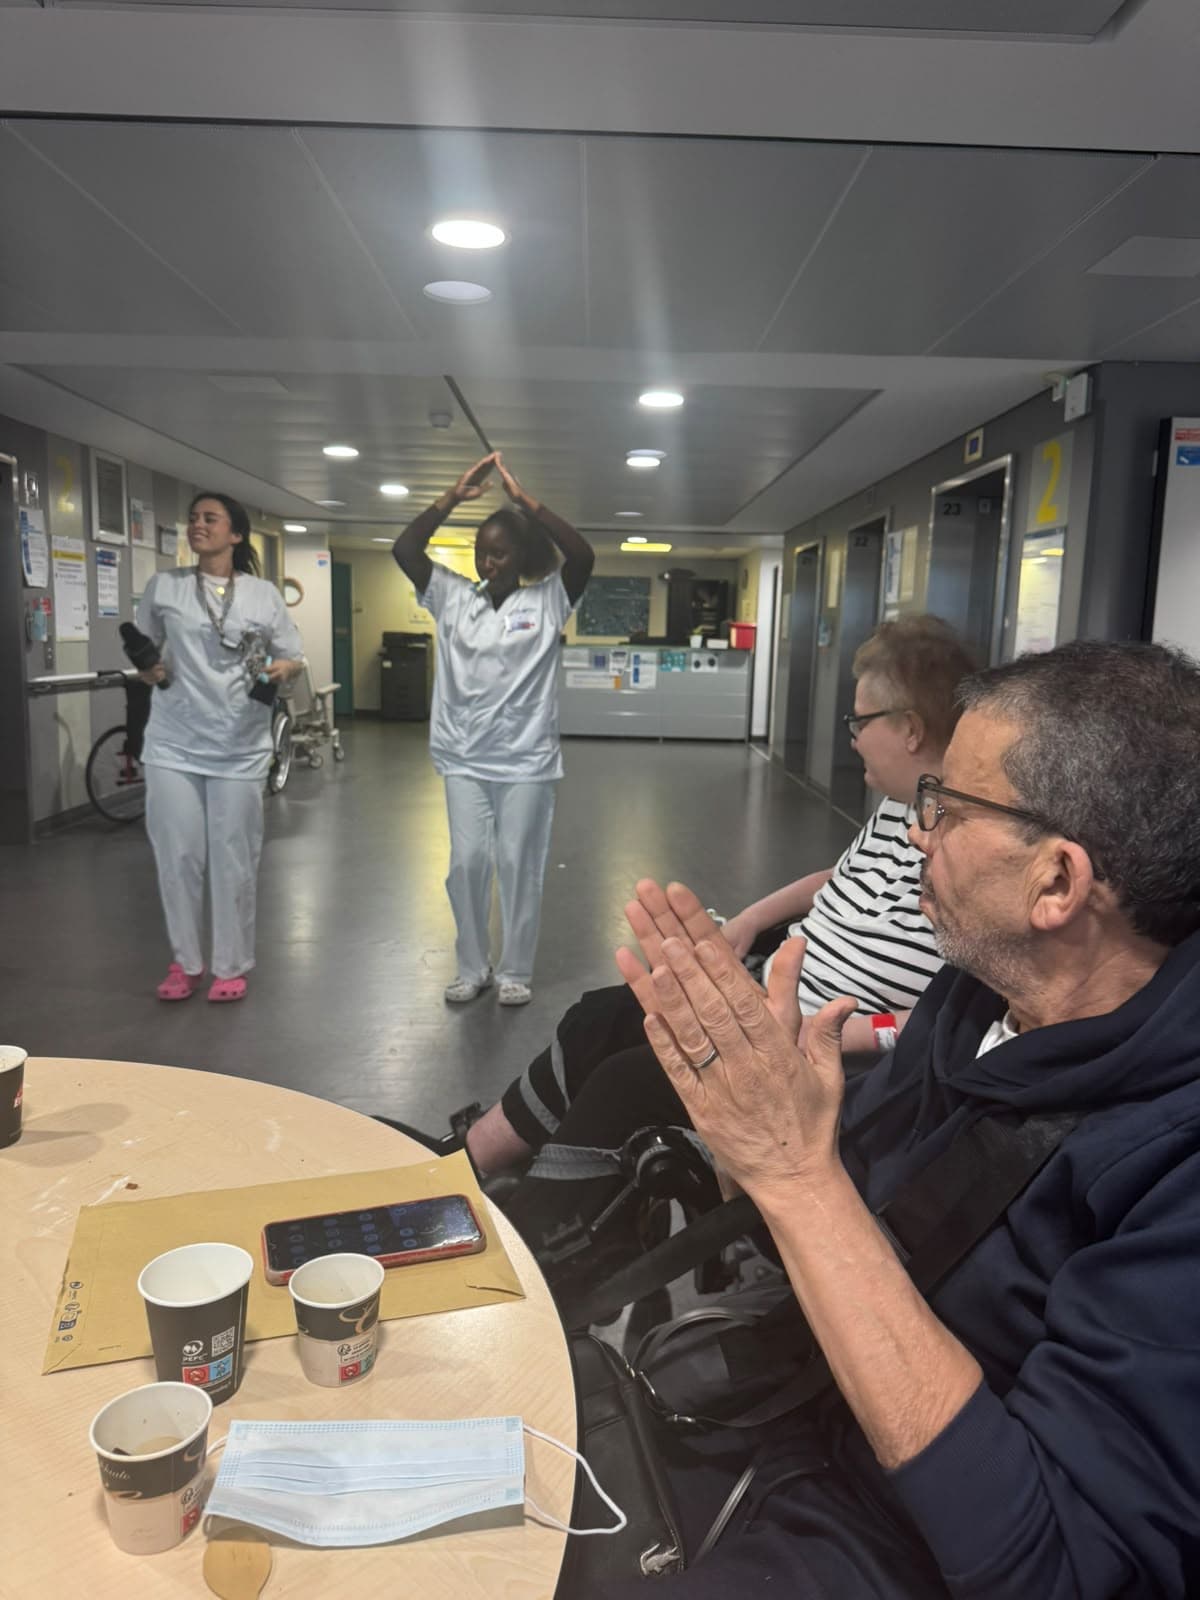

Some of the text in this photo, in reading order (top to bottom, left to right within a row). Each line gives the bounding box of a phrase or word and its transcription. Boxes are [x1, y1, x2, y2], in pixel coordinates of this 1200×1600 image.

[55, 455, 75, 512] 2
[943, 502, 961, 516] 23
[1036, 441, 1062, 523] 2
